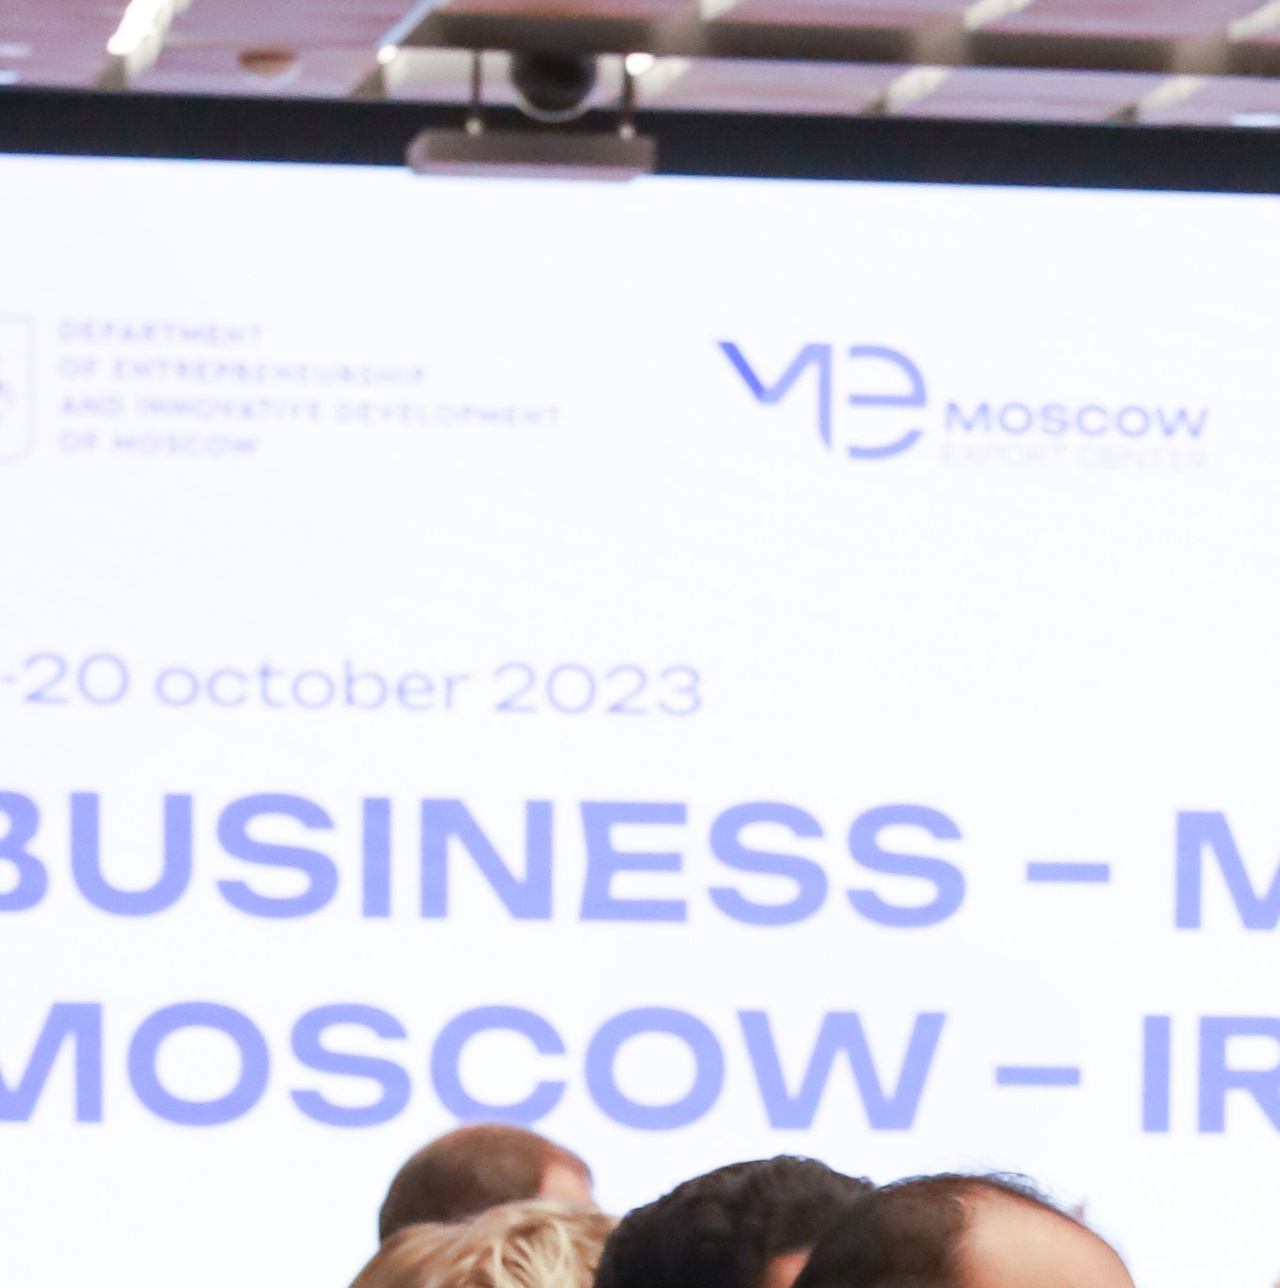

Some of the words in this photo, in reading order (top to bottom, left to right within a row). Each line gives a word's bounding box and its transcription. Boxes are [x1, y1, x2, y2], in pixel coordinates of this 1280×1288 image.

[57, 355, 98, 380] OF
[59, 395, 125, 418] AND
[944, 400, 1208, 439] MOSCOW
[57, 431, 98, 455] OF
[111, 433, 258, 458] MOSCOW
[153, 658, 470, 713] october
[492, 660, 704, 718] 2023
[0, 1000, 948, 1131] MOSCOW
